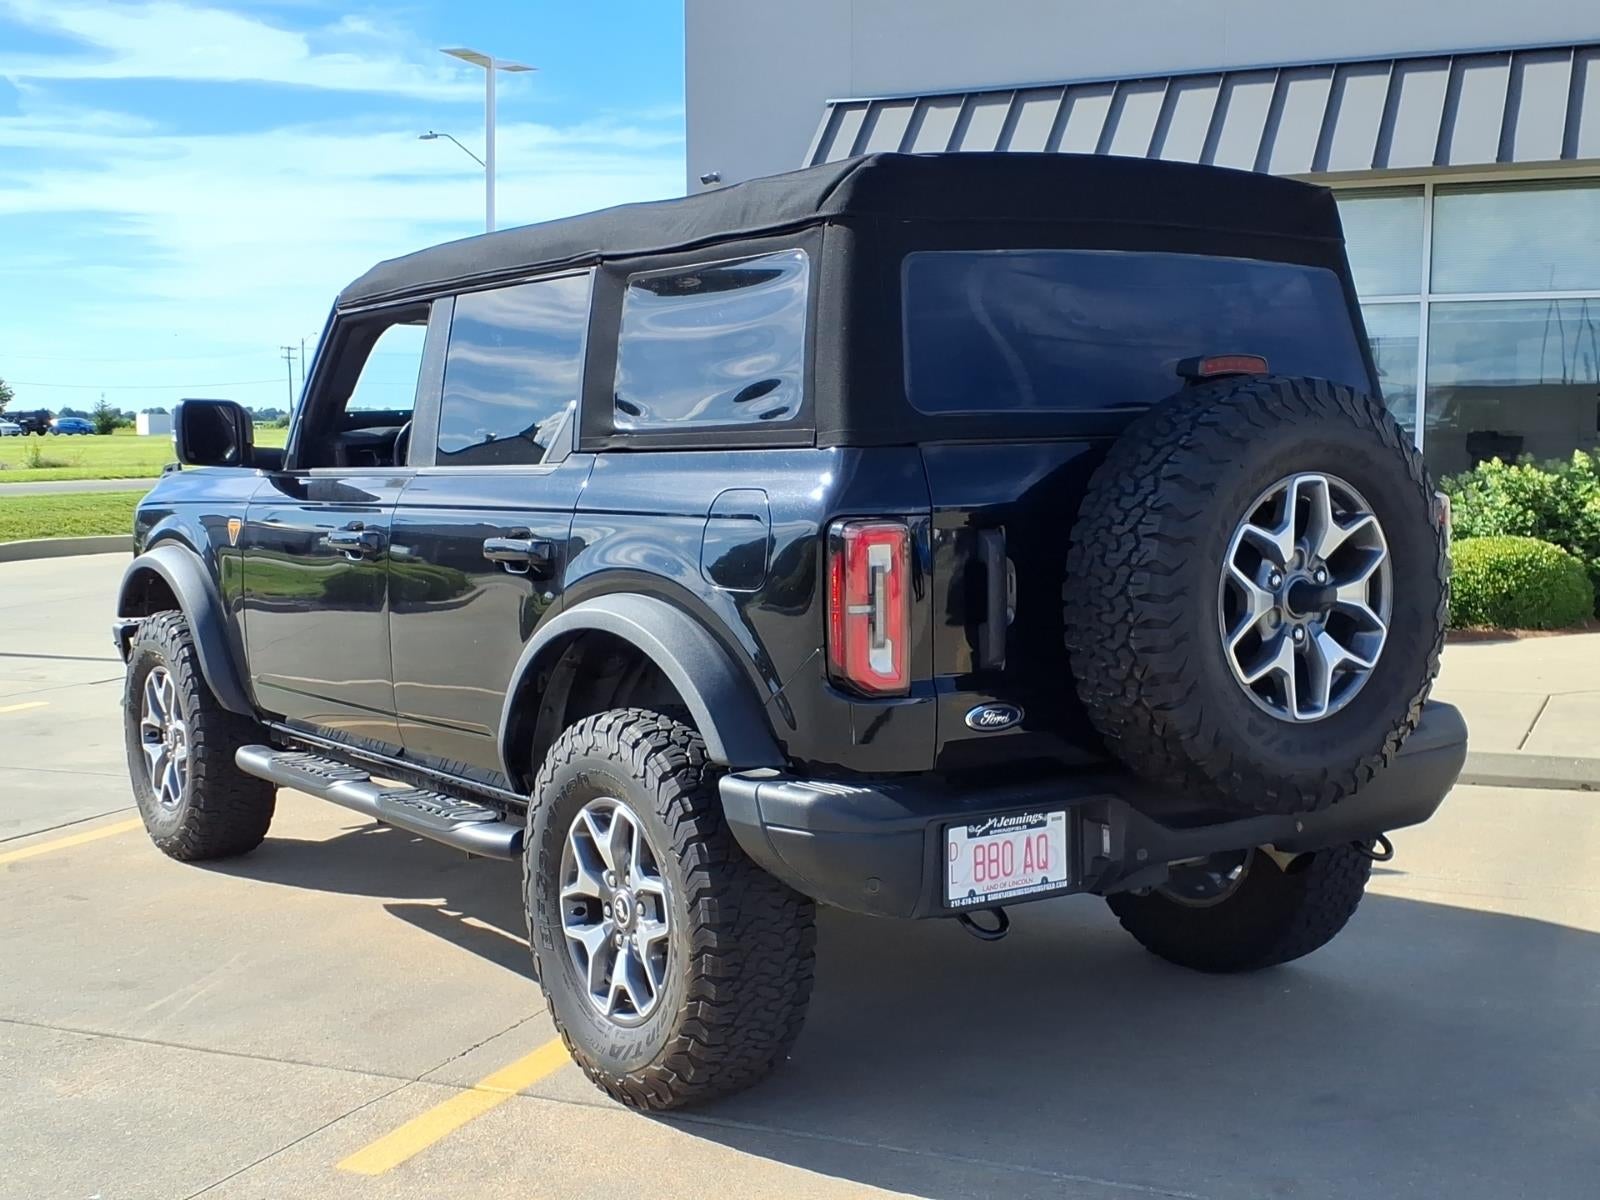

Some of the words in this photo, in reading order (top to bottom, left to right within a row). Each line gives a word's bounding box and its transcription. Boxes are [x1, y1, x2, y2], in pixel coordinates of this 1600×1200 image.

[980, 709, 1010, 725] Ford
[996, 812, 1043, 828] Jennings
[973, 839, 1014, 883] 880
[1023, 833, 1049, 875] AQ
[982, 883, 999, 892] LAND
[999, 880, 1007, 889] OF
[1008, 877, 1034, 888] LINCOLN
